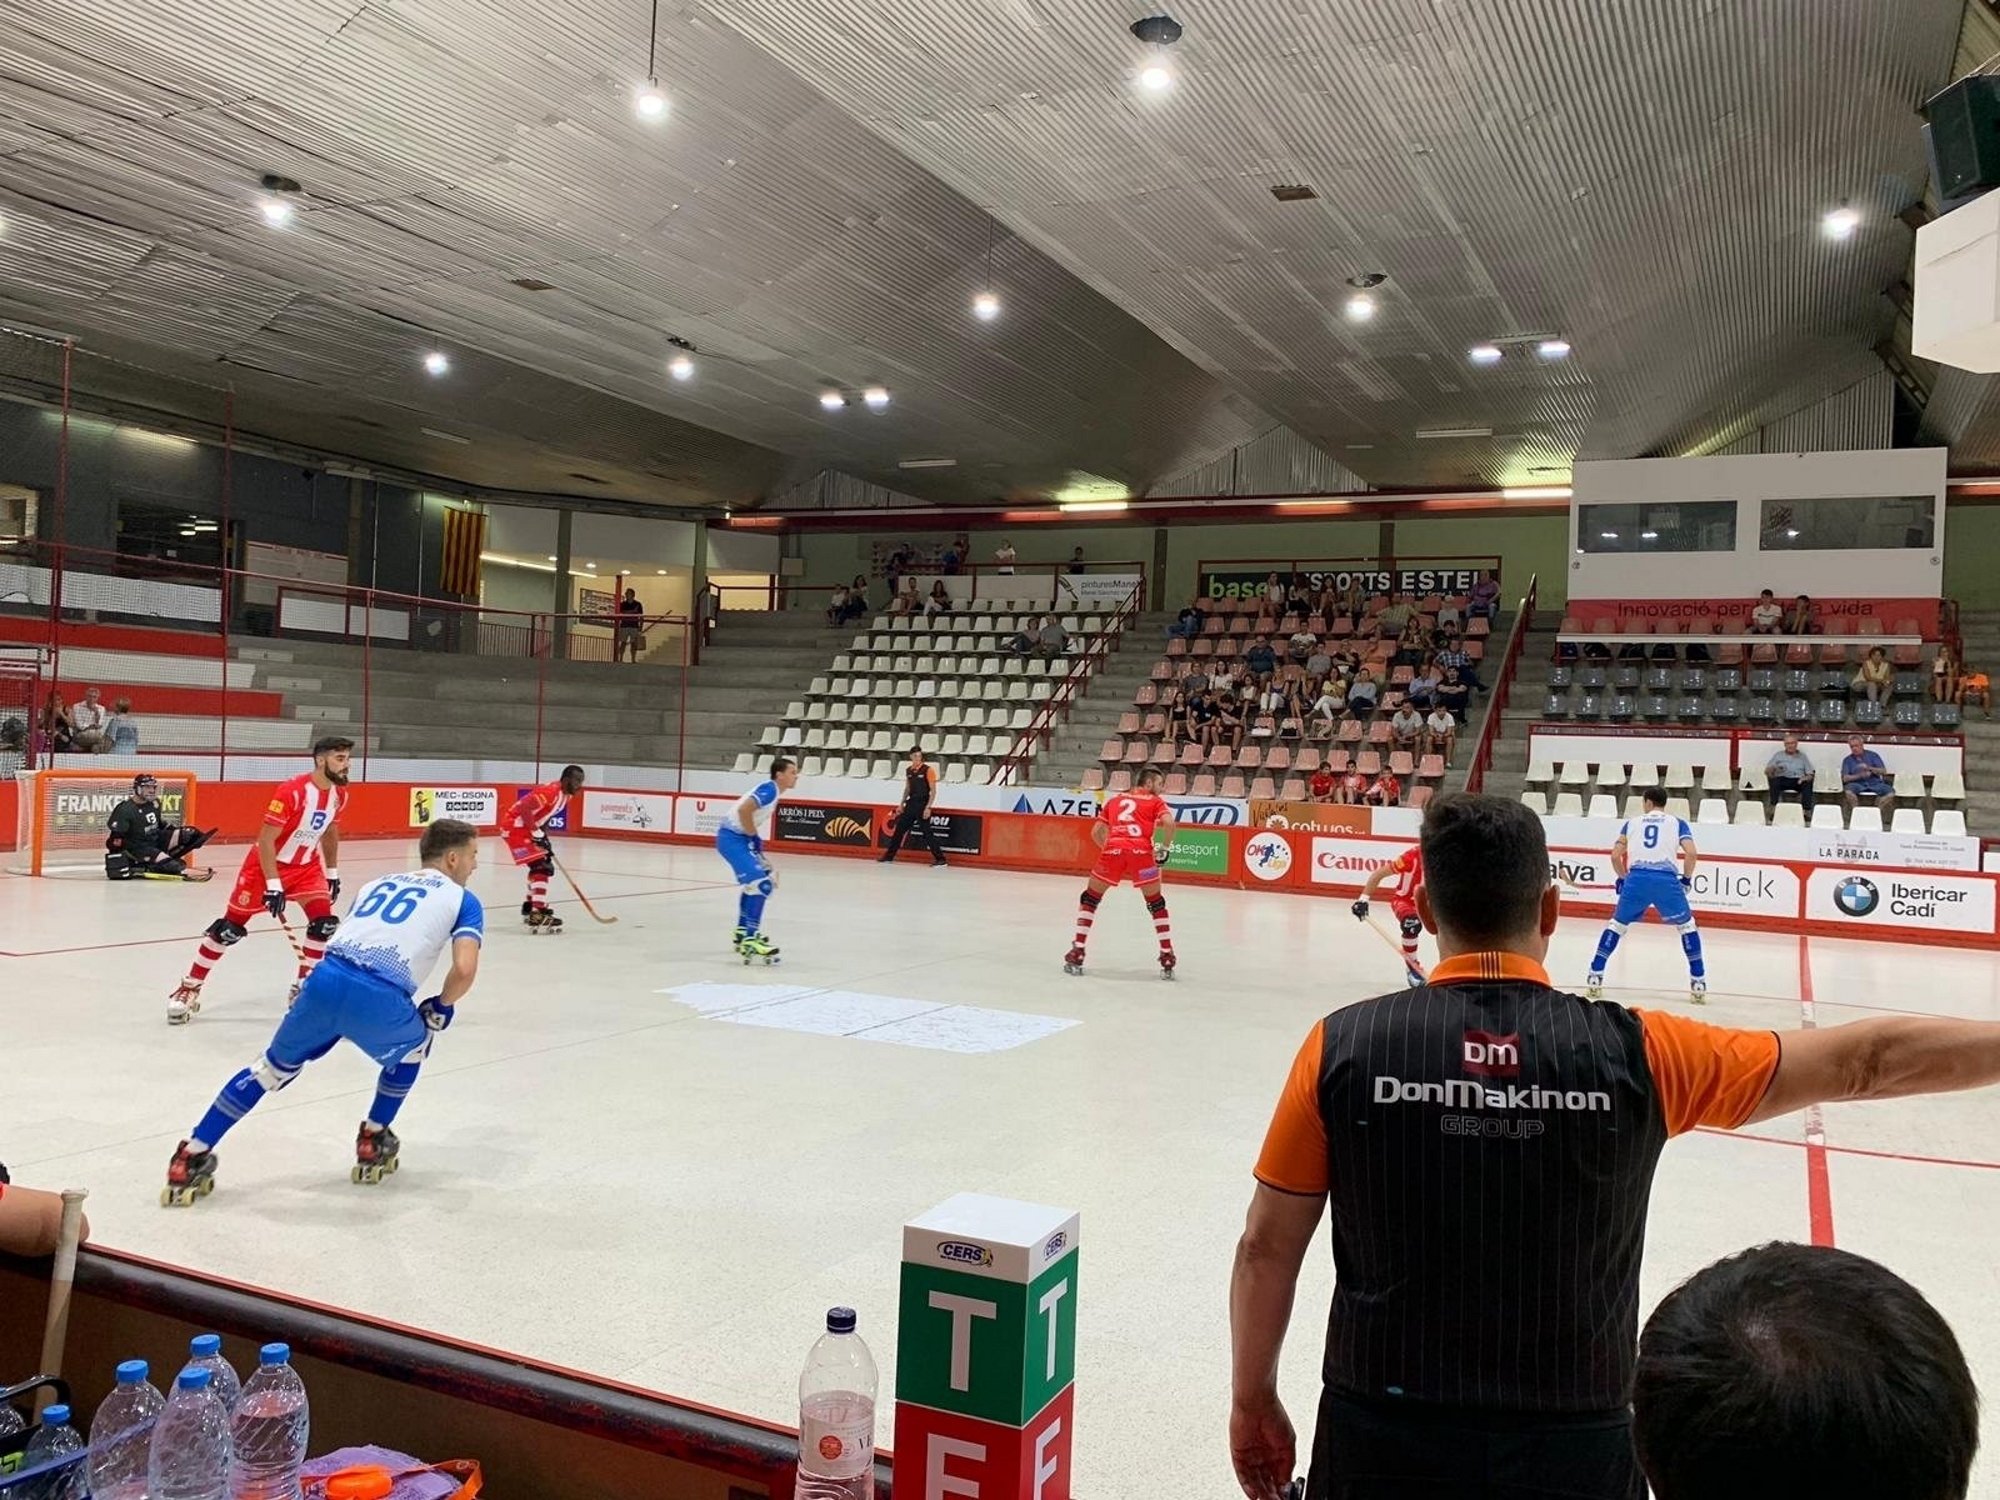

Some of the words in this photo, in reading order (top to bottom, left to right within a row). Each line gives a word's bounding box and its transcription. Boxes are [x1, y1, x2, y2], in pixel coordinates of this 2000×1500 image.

[1617, 601, 1710, 616] Innovació
[1717, 604, 1751, 619] per
[1830, 600, 1873, 616] vida
[1117, 799, 1136, 823] 2
[1643, 824, 1659, 849] 9
[1819, 847, 1832, 858] LA
[1836, 849, 1880, 860] PARADA
[354, 881, 428, 924] 66
[1891, 883, 1968, 902] Ibericar
[1890, 900, 1936, 918] Cadí
[1373, 1076, 1611, 1111] DonMakinon
[1440, 1114, 1545, 1139] GROUP
[942, 1243, 983, 1261] CERS
[928, 1290, 997, 1392] T
[1039, 1277, 1068, 1382] T
